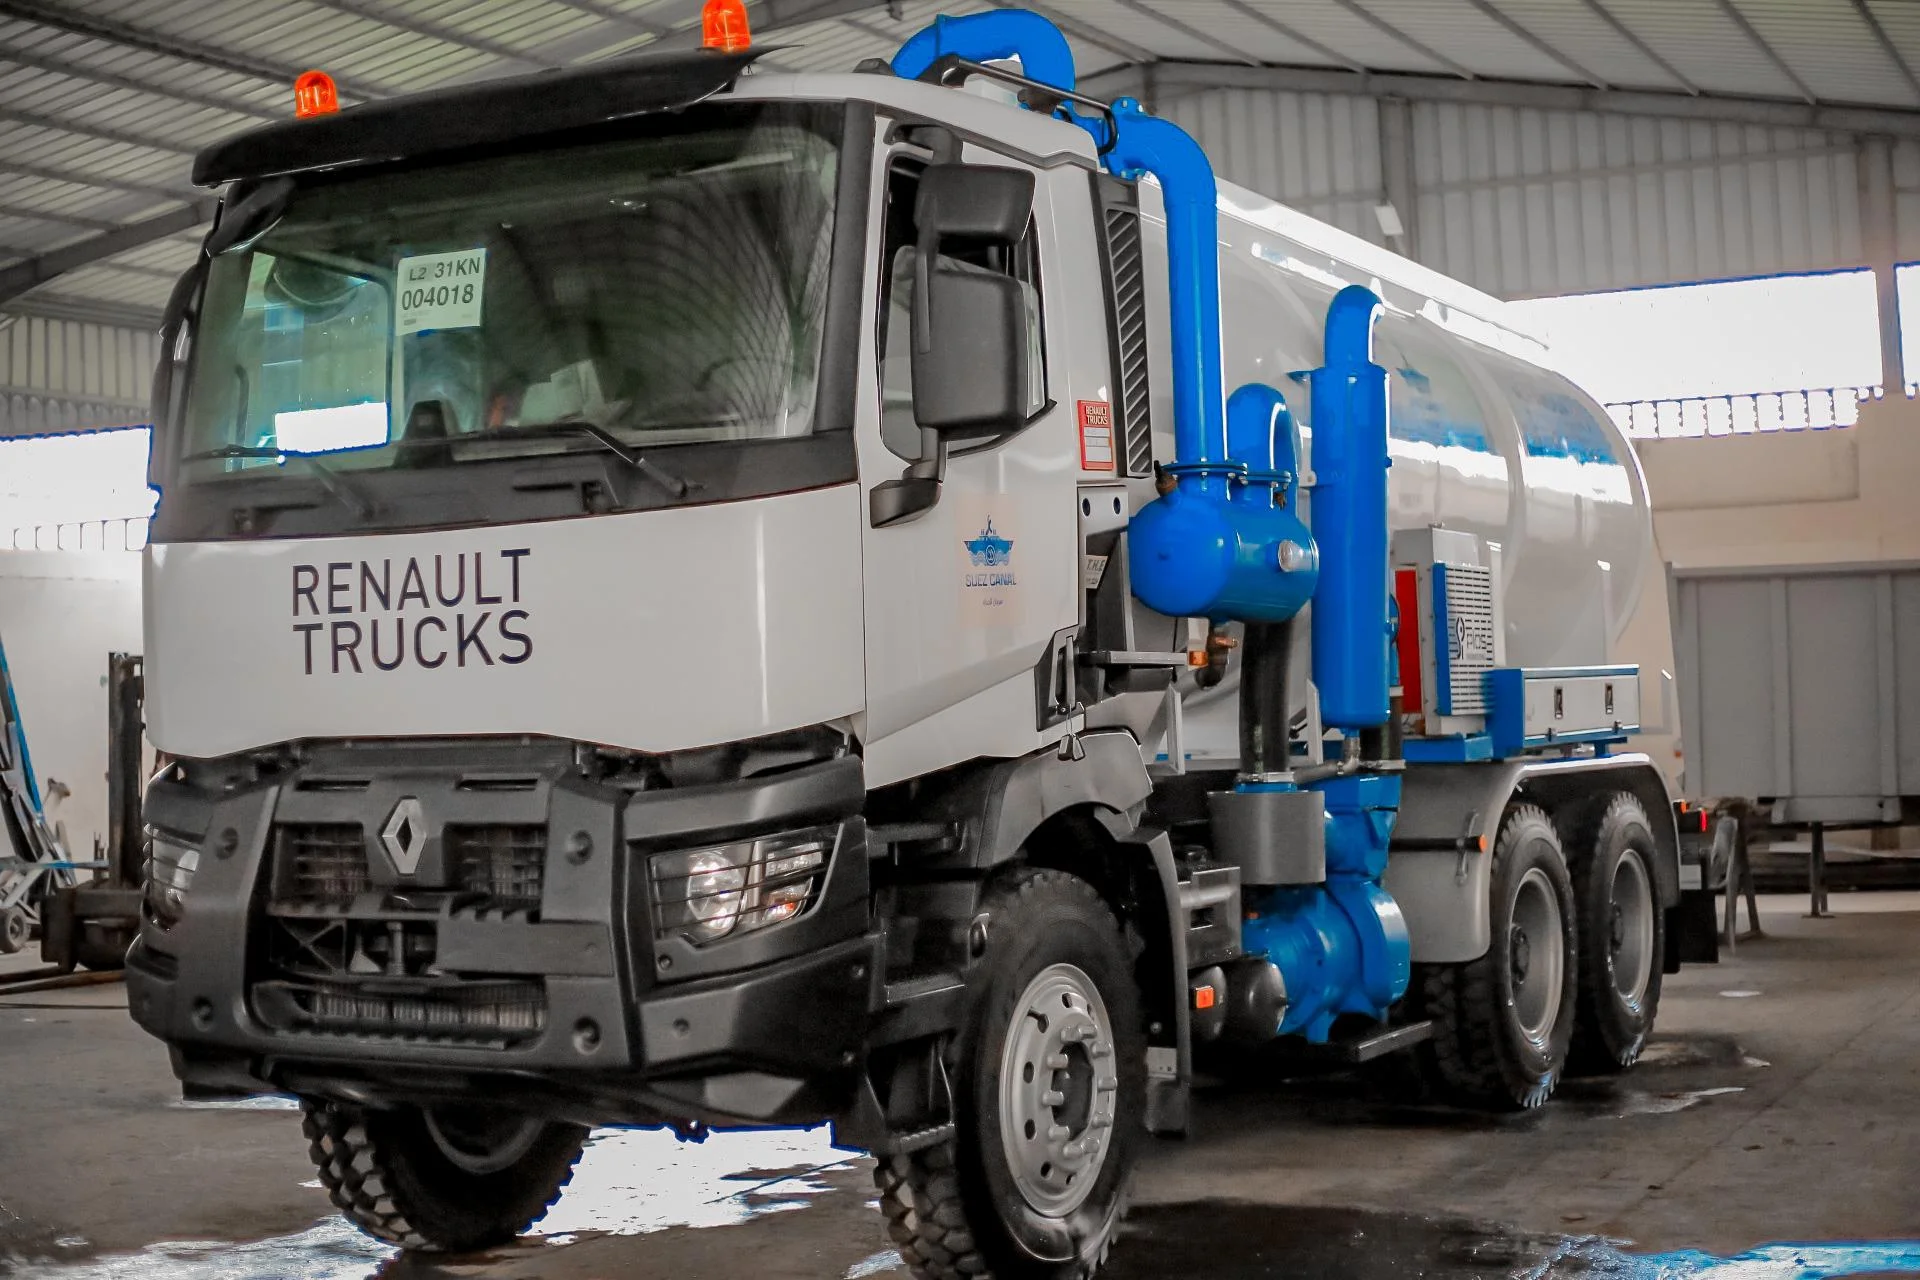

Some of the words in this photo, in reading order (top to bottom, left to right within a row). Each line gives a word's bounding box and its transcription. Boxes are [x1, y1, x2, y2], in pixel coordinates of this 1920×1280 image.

[409, 267, 427, 281] L2
[434, 257, 480, 278] 31KN
[402, 283, 474, 310] 004018
[1085, 405, 1107, 415] RENAULT
[1086, 415, 1109, 425] TRUCKS
[293, 548, 531, 616] RENAULT
[966, 574, 988, 587] SUEZ
[990, 573, 1017, 586] CANAL
[293, 609, 533, 675] TRUCKS
